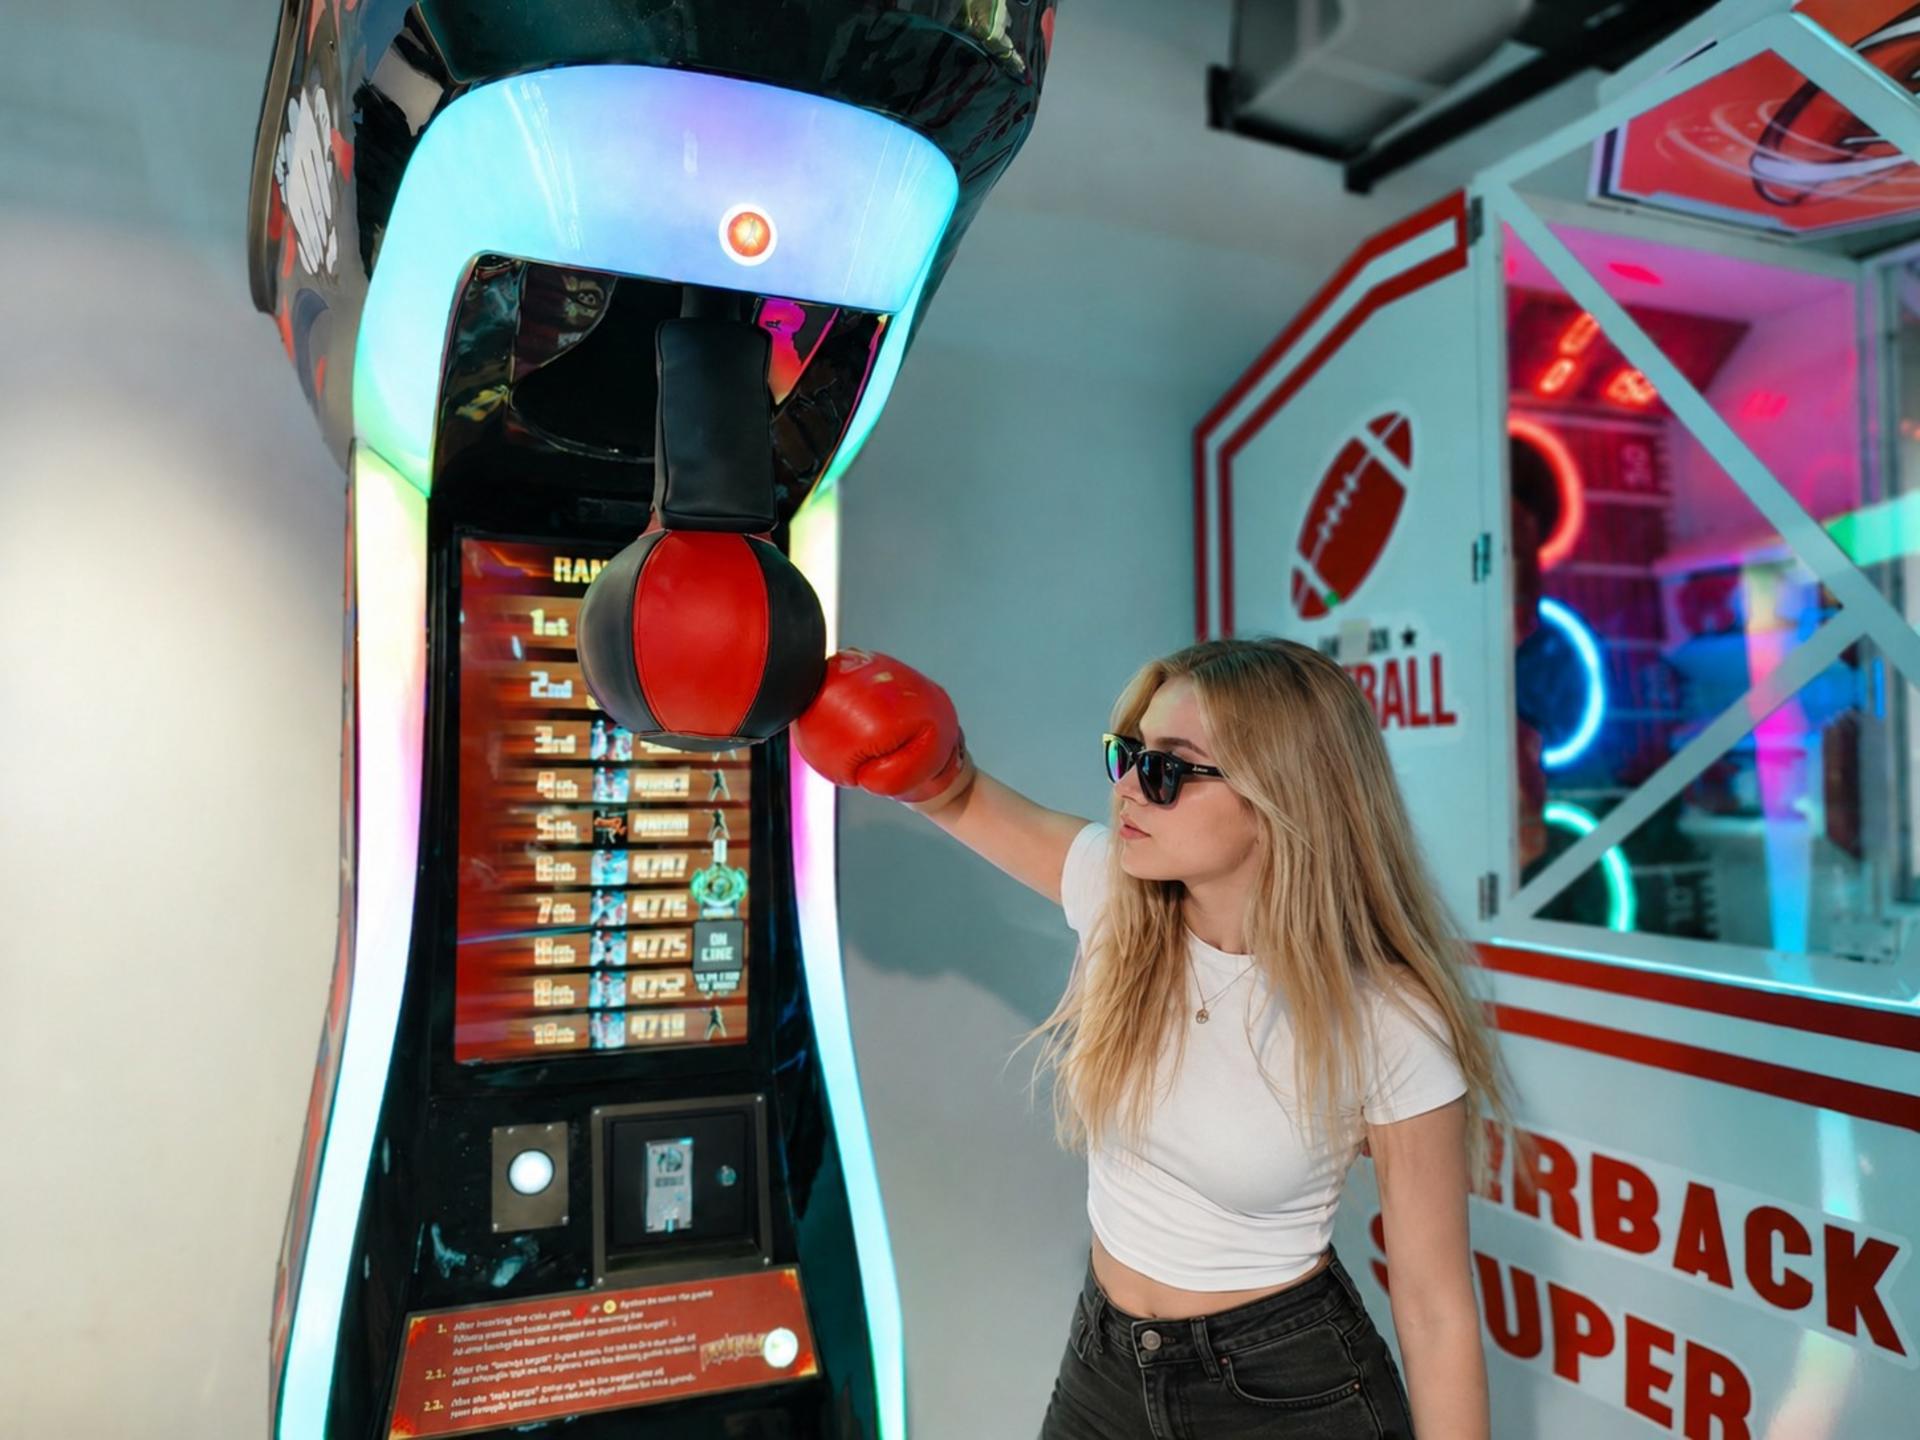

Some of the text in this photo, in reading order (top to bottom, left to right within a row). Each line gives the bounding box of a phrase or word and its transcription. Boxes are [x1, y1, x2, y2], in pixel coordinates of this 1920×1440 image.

[530, 609, 569, 637] 1st
[530, 671, 572, 698] 2nd
[1344, 652, 1458, 729] BALL
[535, 726, 576, 754] 3rd
[536, 814, 577, 840] 5th
[535, 897, 576, 924] 7th
[709, 932, 728, 946] ON
[701, 946, 734, 962] LINE
